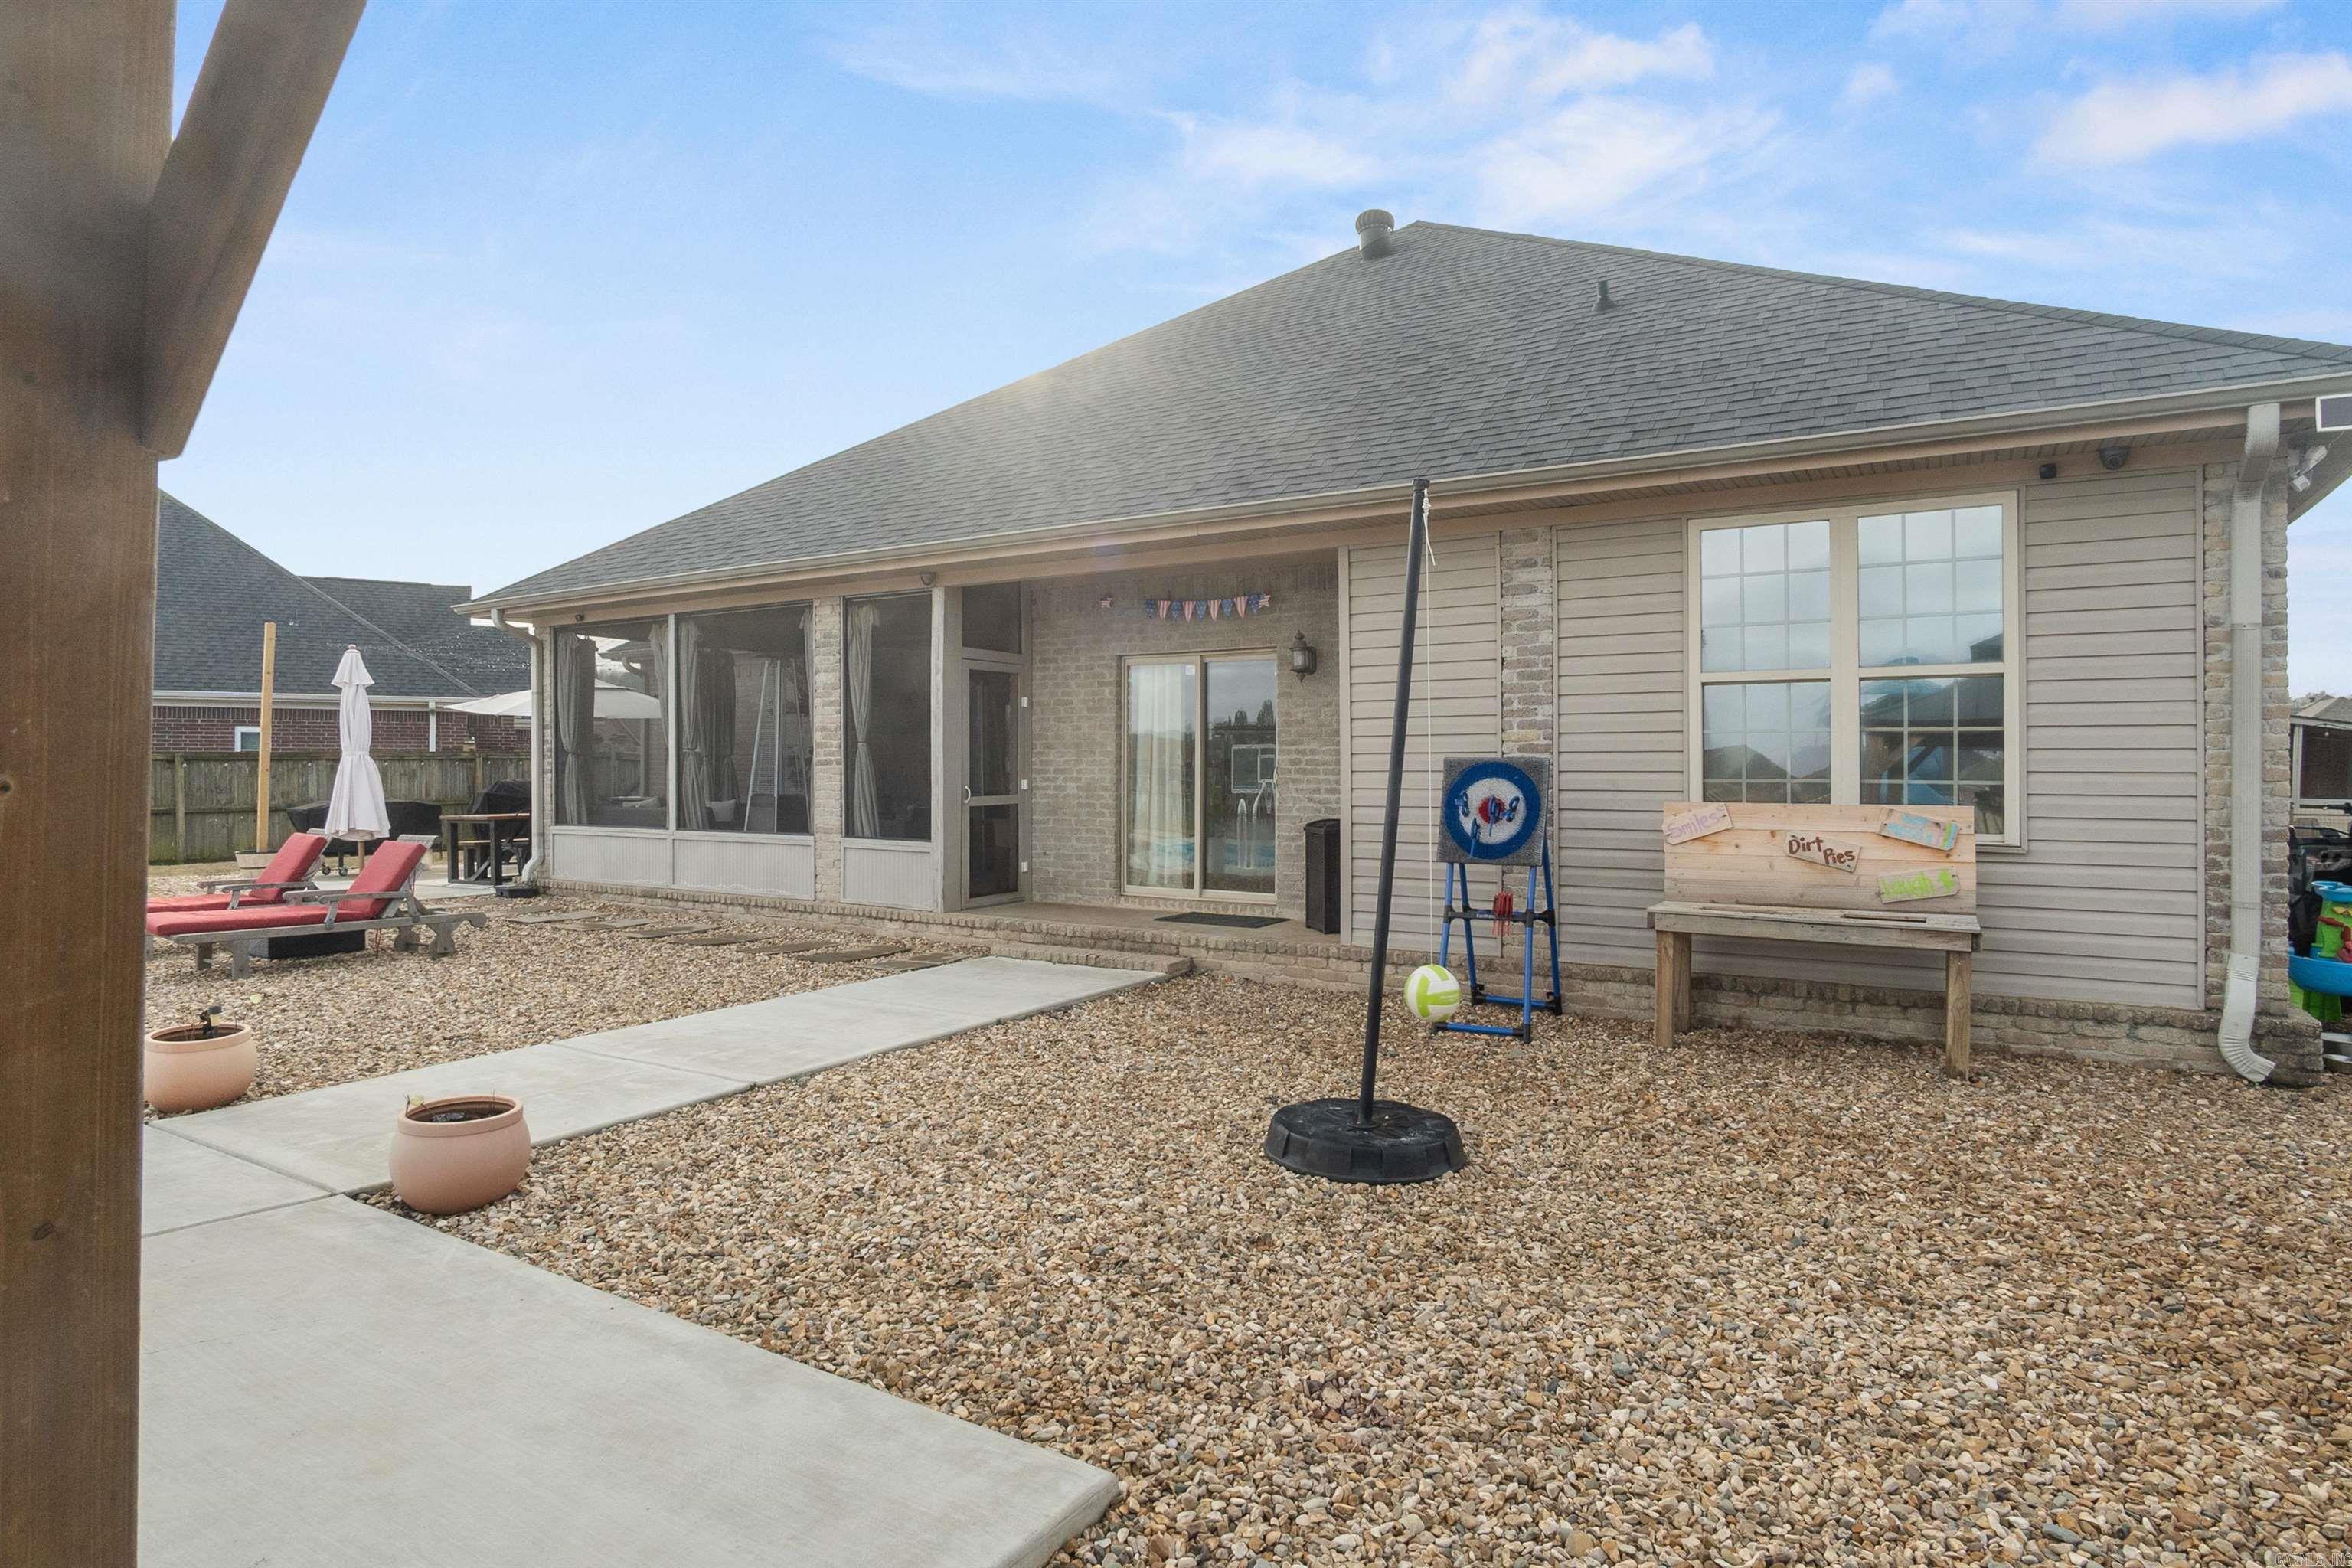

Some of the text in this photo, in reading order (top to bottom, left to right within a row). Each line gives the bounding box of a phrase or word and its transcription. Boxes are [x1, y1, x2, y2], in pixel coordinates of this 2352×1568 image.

[1666, 812, 1719, 838] Smiles
[1788, 837, 1855, 865] Dirt Pies
